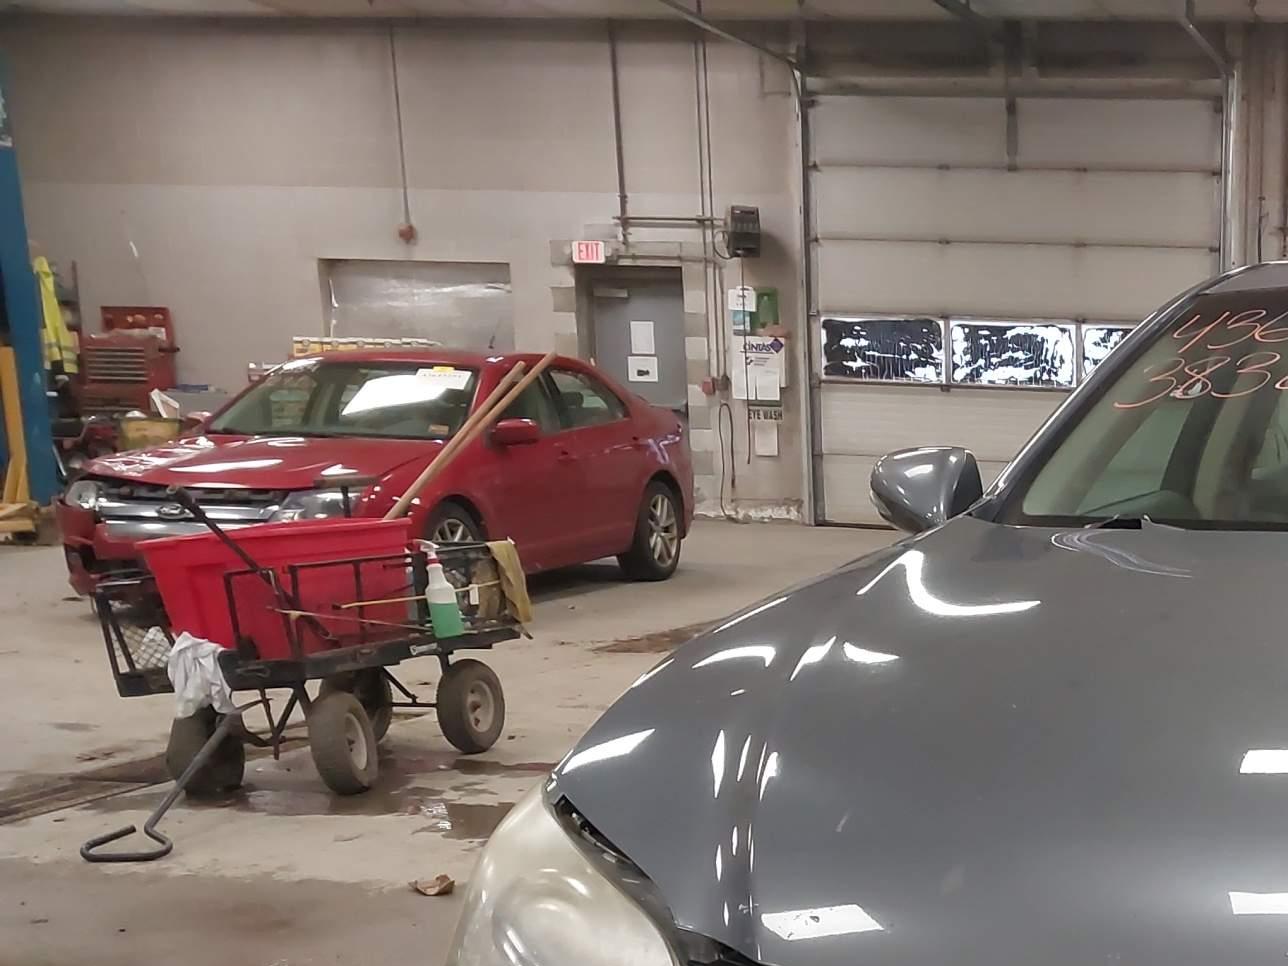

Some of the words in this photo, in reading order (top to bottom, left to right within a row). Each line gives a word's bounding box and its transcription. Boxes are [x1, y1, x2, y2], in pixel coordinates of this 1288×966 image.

[578, 242, 601, 261] EXIT
[748, 408, 761, 420] EYE
[763, 410, 783, 421] WASH
